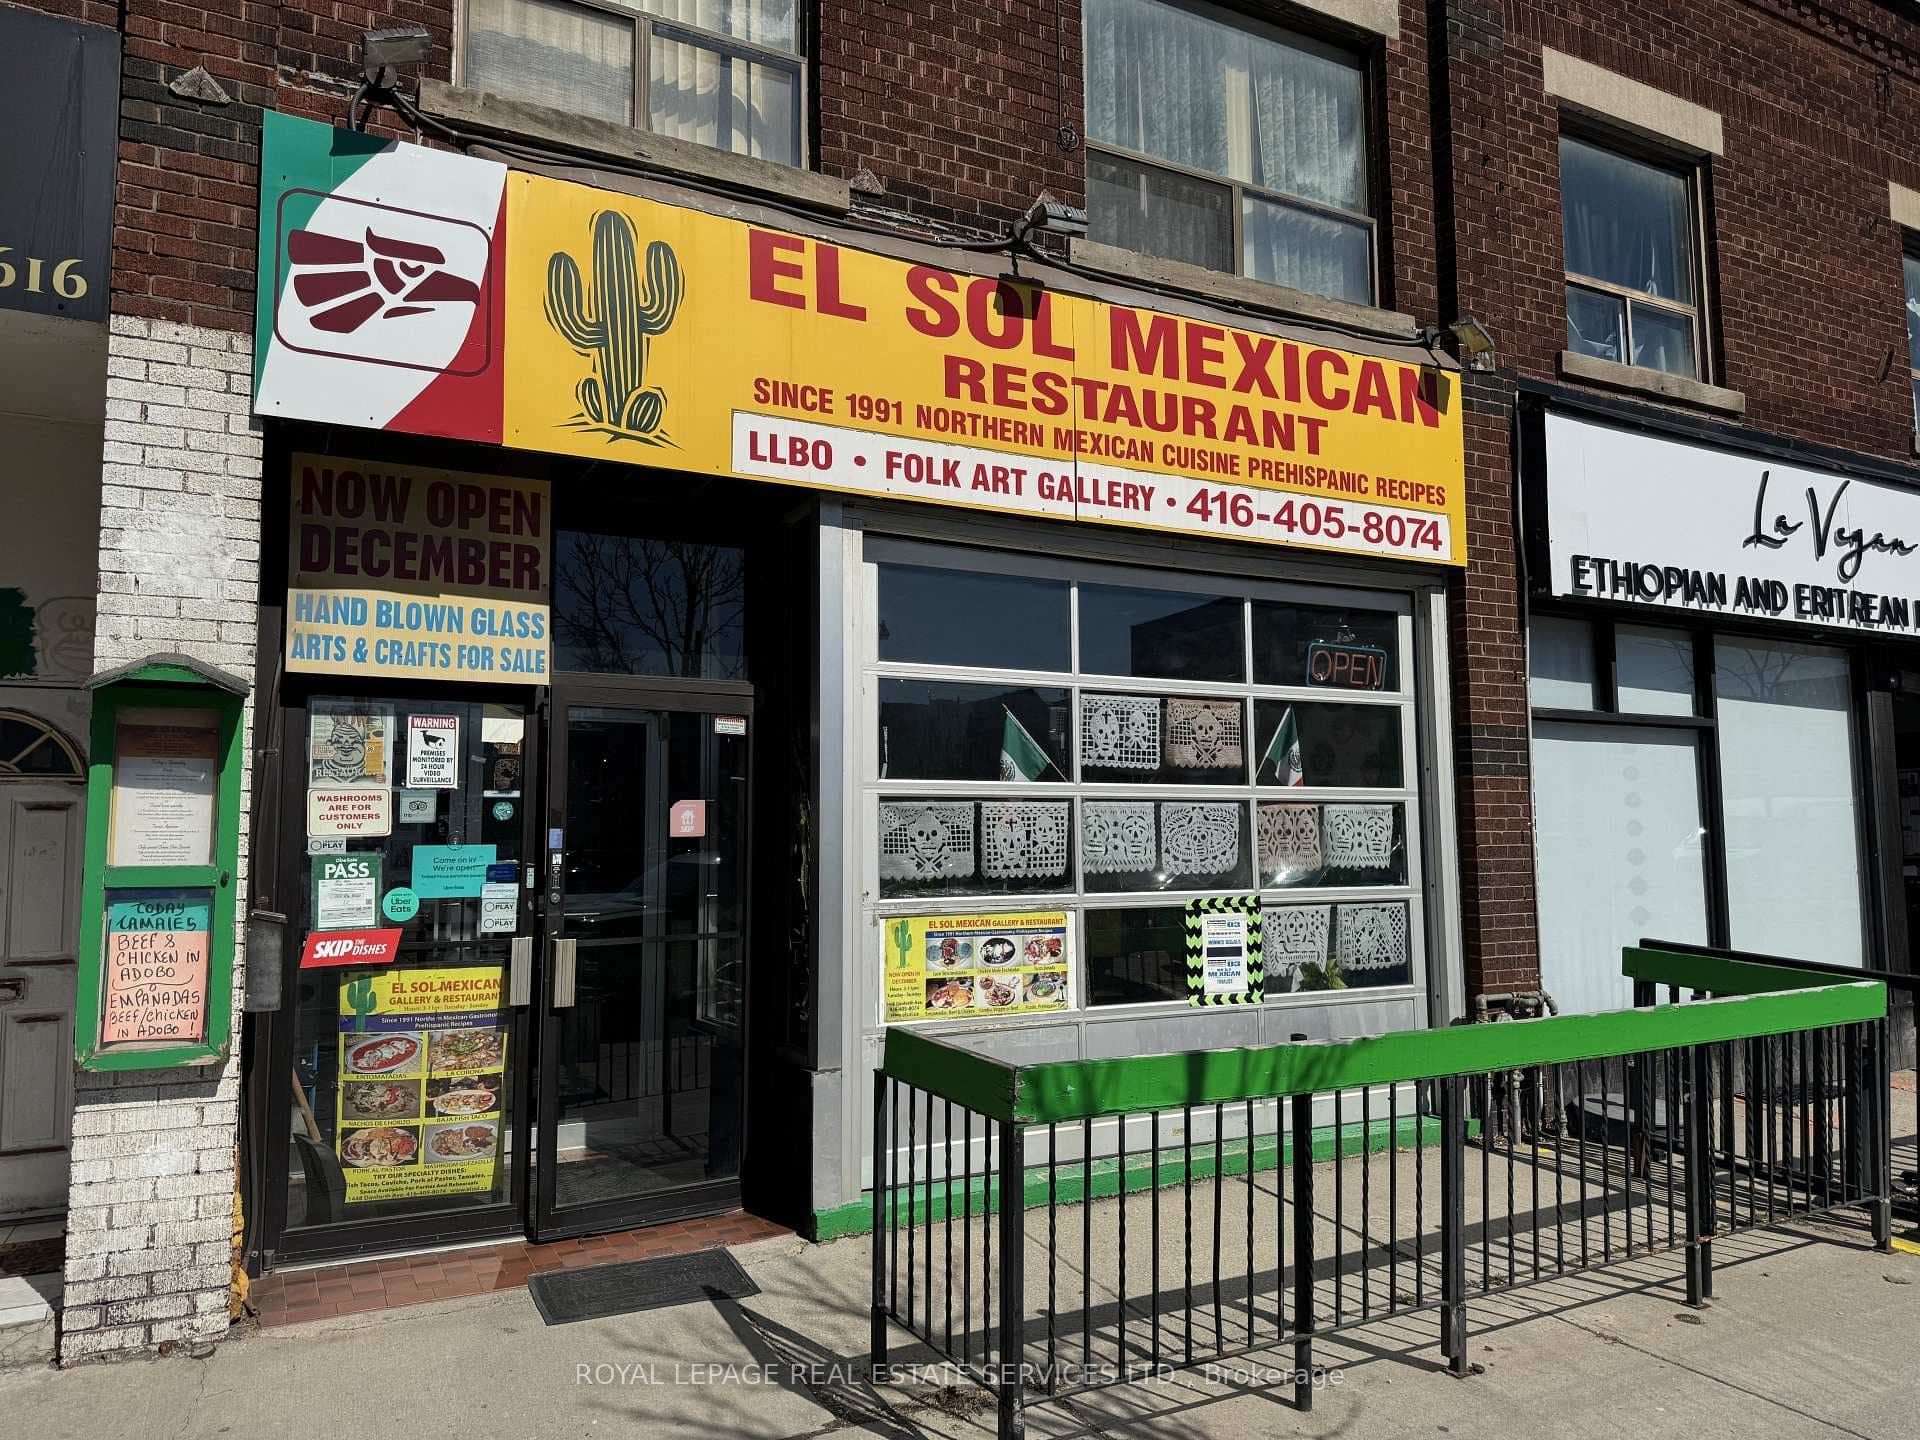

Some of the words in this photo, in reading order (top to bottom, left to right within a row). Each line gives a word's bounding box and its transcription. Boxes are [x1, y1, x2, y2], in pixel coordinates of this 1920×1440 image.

[749, 228, 867, 322] EL
[905, 264, 1075, 361] SOL
[1110, 305, 1440, 429] MEXICAN
[943, 354, 1329, 456] RESTAURANT
[754, 377, 833, 415] SINCE
[846, 393, 902, 425] 1991
[917, 404, 1044, 448] NORTHERN
[1054, 427, 1154, 464] MEXICAN
[1162, 443, 1240, 477] CUISINE
[1249, 457, 1369, 495] PREHISPANIC
[1376, 476, 1446, 506] RECIPES
[749, 430, 833, 471] LLBO
[886, 450, 962, 489] FOLK
[971, 463, 1028, 496] ART
[1038, 472, 1155, 512] GALLERY
[1186, 488, 1443, 552] 416-405-8074
[301, 466, 412, 524] NOW
[427, 480, 541, 538] OPEN
[1742, 470, 1804, 549] La
[1805, 480, 1919, 584] Vegan
[301, 523, 540, 591] DECEMBER
[1570, 554, 1728, 607] ETHIOPIAN
[1734, 575, 1788, 614] AND
[1793, 583, 1910, 631] ERITREAN
[295, 592, 368, 627] HAND
[375, 599, 464, 634] BLOWN
[471, 608, 545, 640] GLASS
[291, 633, 347, 662] ARTS
[353, 637, 369, 664] &
[375, 639, 451, 668] CRAFTS
[457, 645, 494, 671] FOR
[500, 647, 545, 674] SALE
[1312, 650, 1384, 686] OPEN
[414, 717, 455, 728] WARNING
[318, 813, 381, 821] CUSTOMERS
[336, 822, 363, 830] ONLY
[325, 863, 370, 879] PASS
[130, 902, 185, 916] TODAY
[390, 905, 412, 913] Eats
[928, 920, 938, 928] EL
[939, 920, 955, 928] SOL
[956, 919, 991, 927] MEXICAN
[117, 932, 159, 951] BEEF
[313, 940, 353, 958] SKIP
[352, 944, 388, 956] DISHES
[116, 950, 179, 966] CHICKEN
[187, 950, 200, 963] IN
[120, 966, 176, 981] ADOBO
[392, 981, 407, 994] EL
[411, 980, 435, 993] SOL
[440, 978, 503, 992] MEXICAN
[110, 988, 200, 1009] EMPANADAS
[389, 995, 432, 1005] GALLERY
[434, 994, 441, 1003] &
[381, 1016, 398, 1024] Since
[117, 1028, 129, 1038] IN
[137, 1024, 180, 1037] ADOBO
